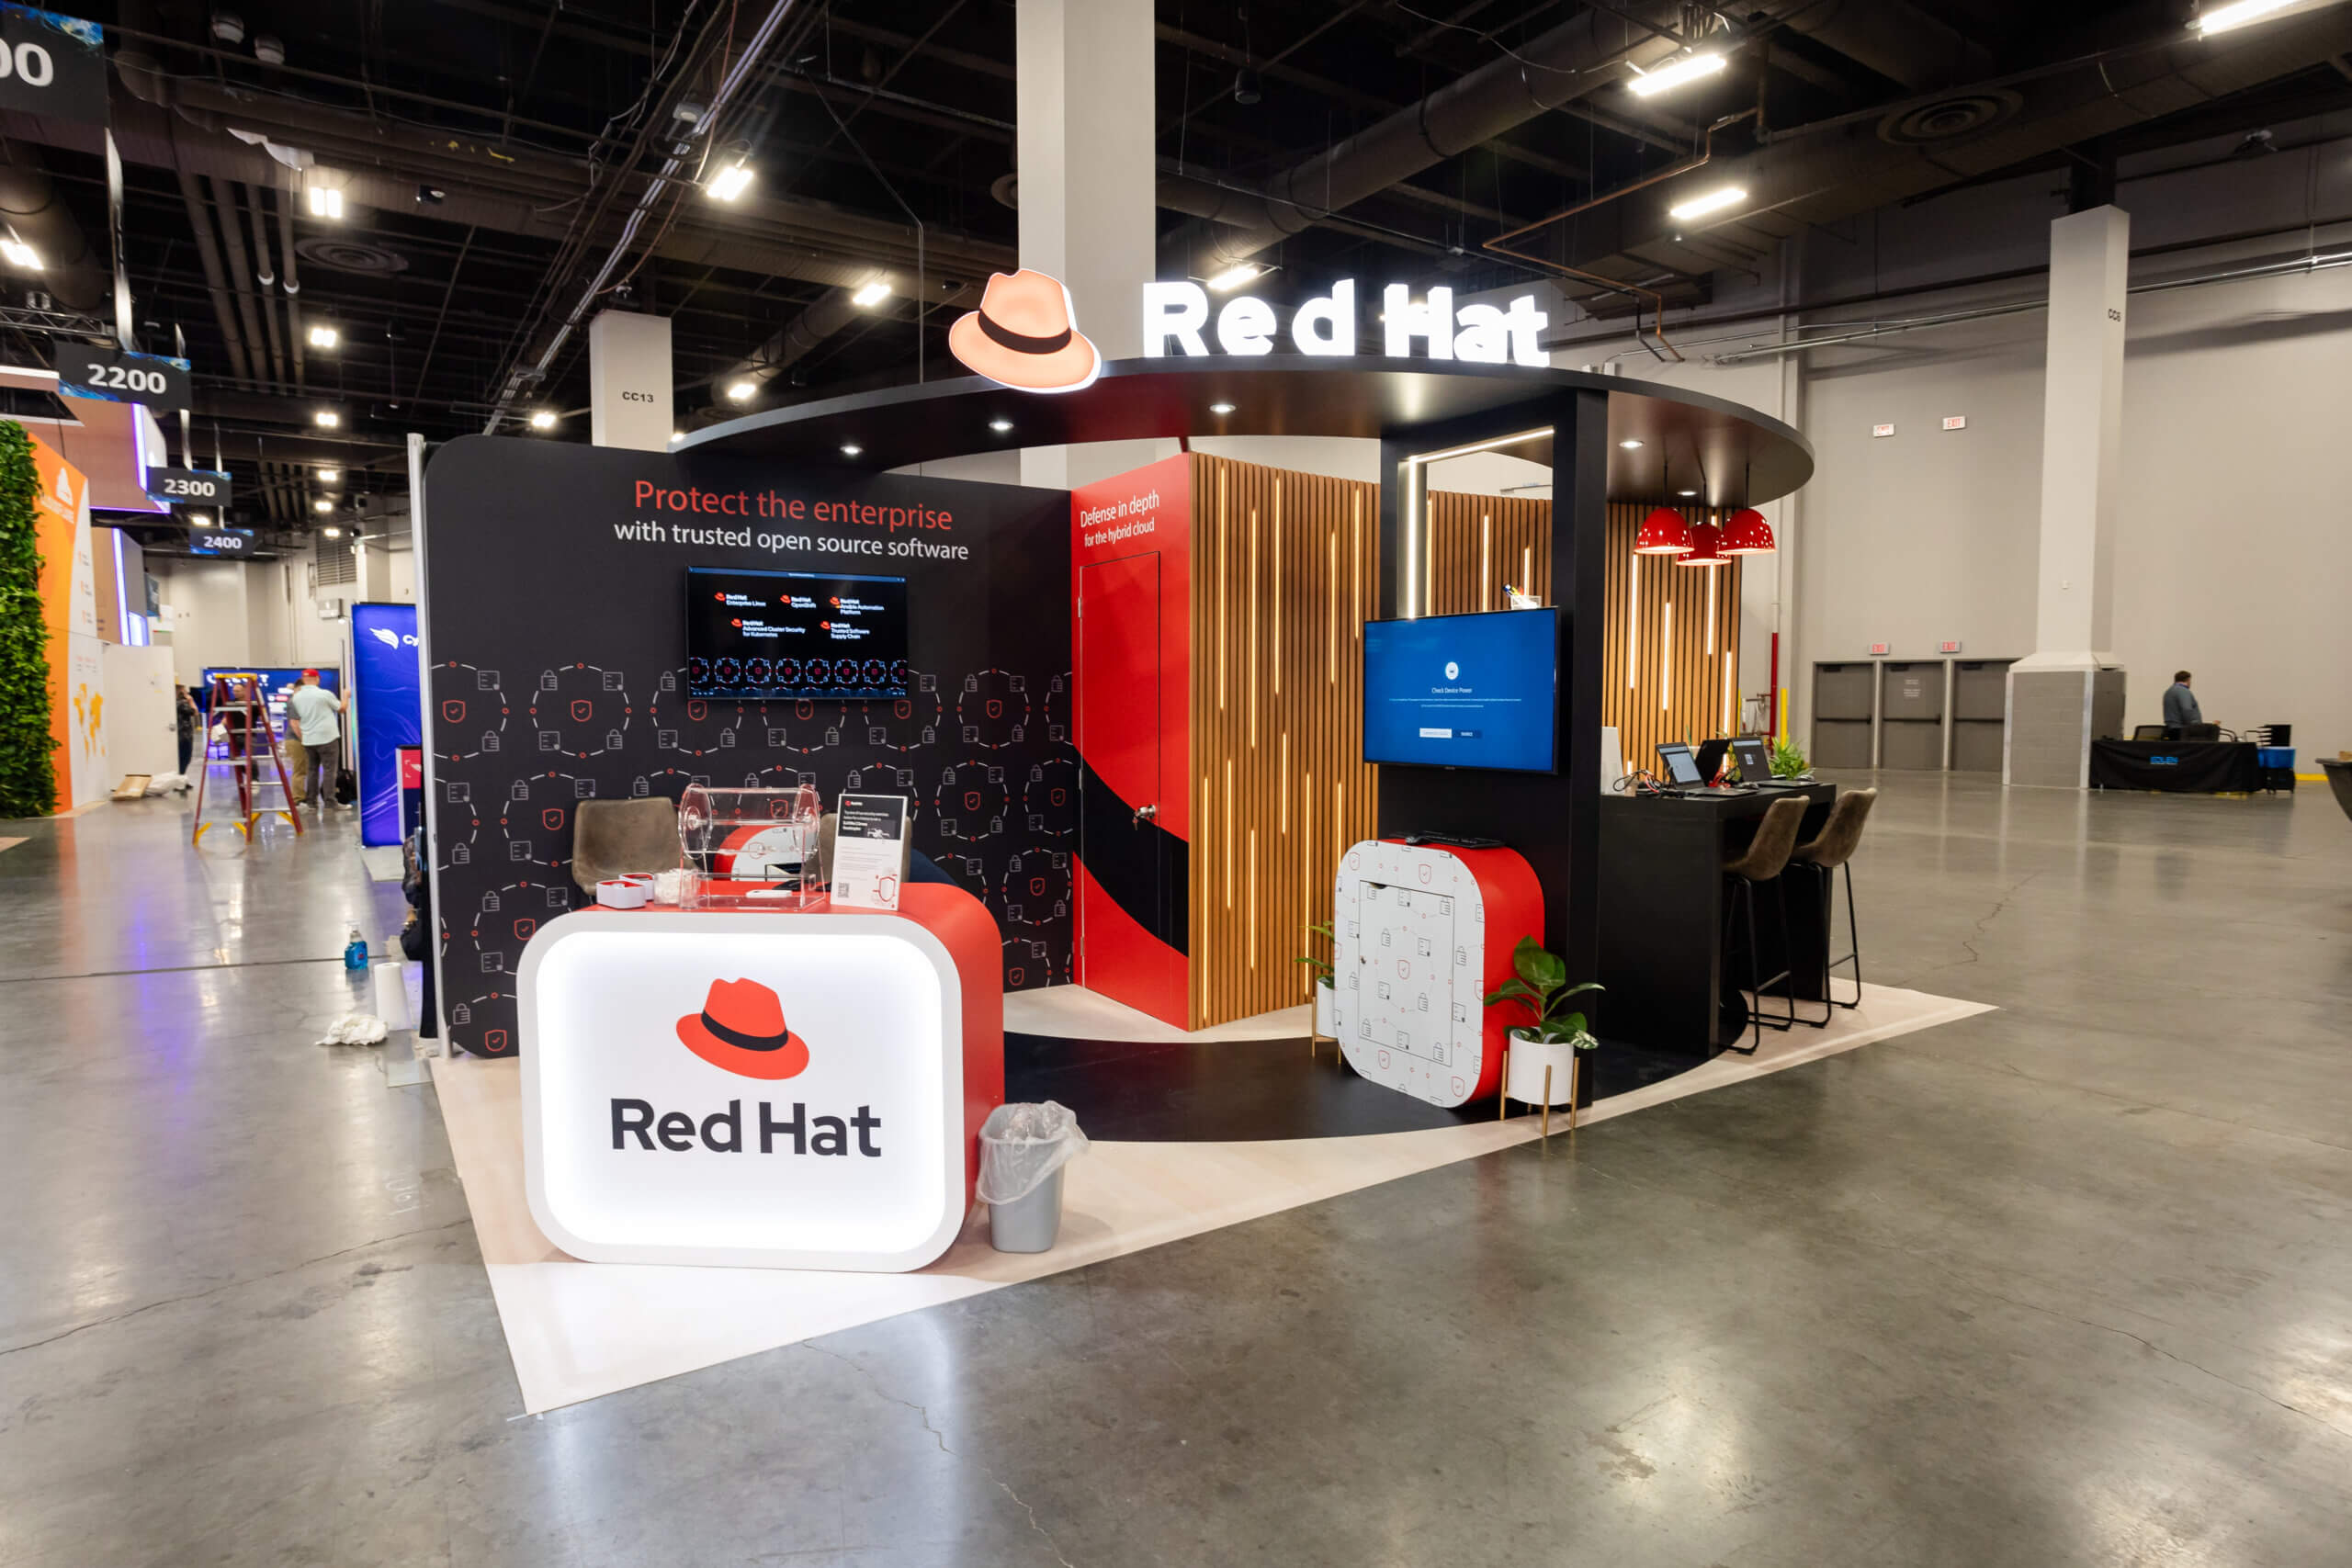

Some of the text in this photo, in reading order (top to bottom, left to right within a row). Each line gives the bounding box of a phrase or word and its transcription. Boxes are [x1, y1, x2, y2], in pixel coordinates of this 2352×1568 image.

[1143, 278, 1551, 367] Red Hat
[87, 364, 167, 394] 2200
[622, 390, 653, 403] CC13
[164, 479, 215, 497] 2300
[635, 479, 953, 533] Protect the enterprise
[1080, 489, 1159, 528] Defense in depth
[203, 536, 243, 549] 2400
[614, 520, 969, 559] with trusted open source software
[1084, 516, 1155, 547] for the hybrid cloud
[611, 1098, 882, 1158] Red Hat
